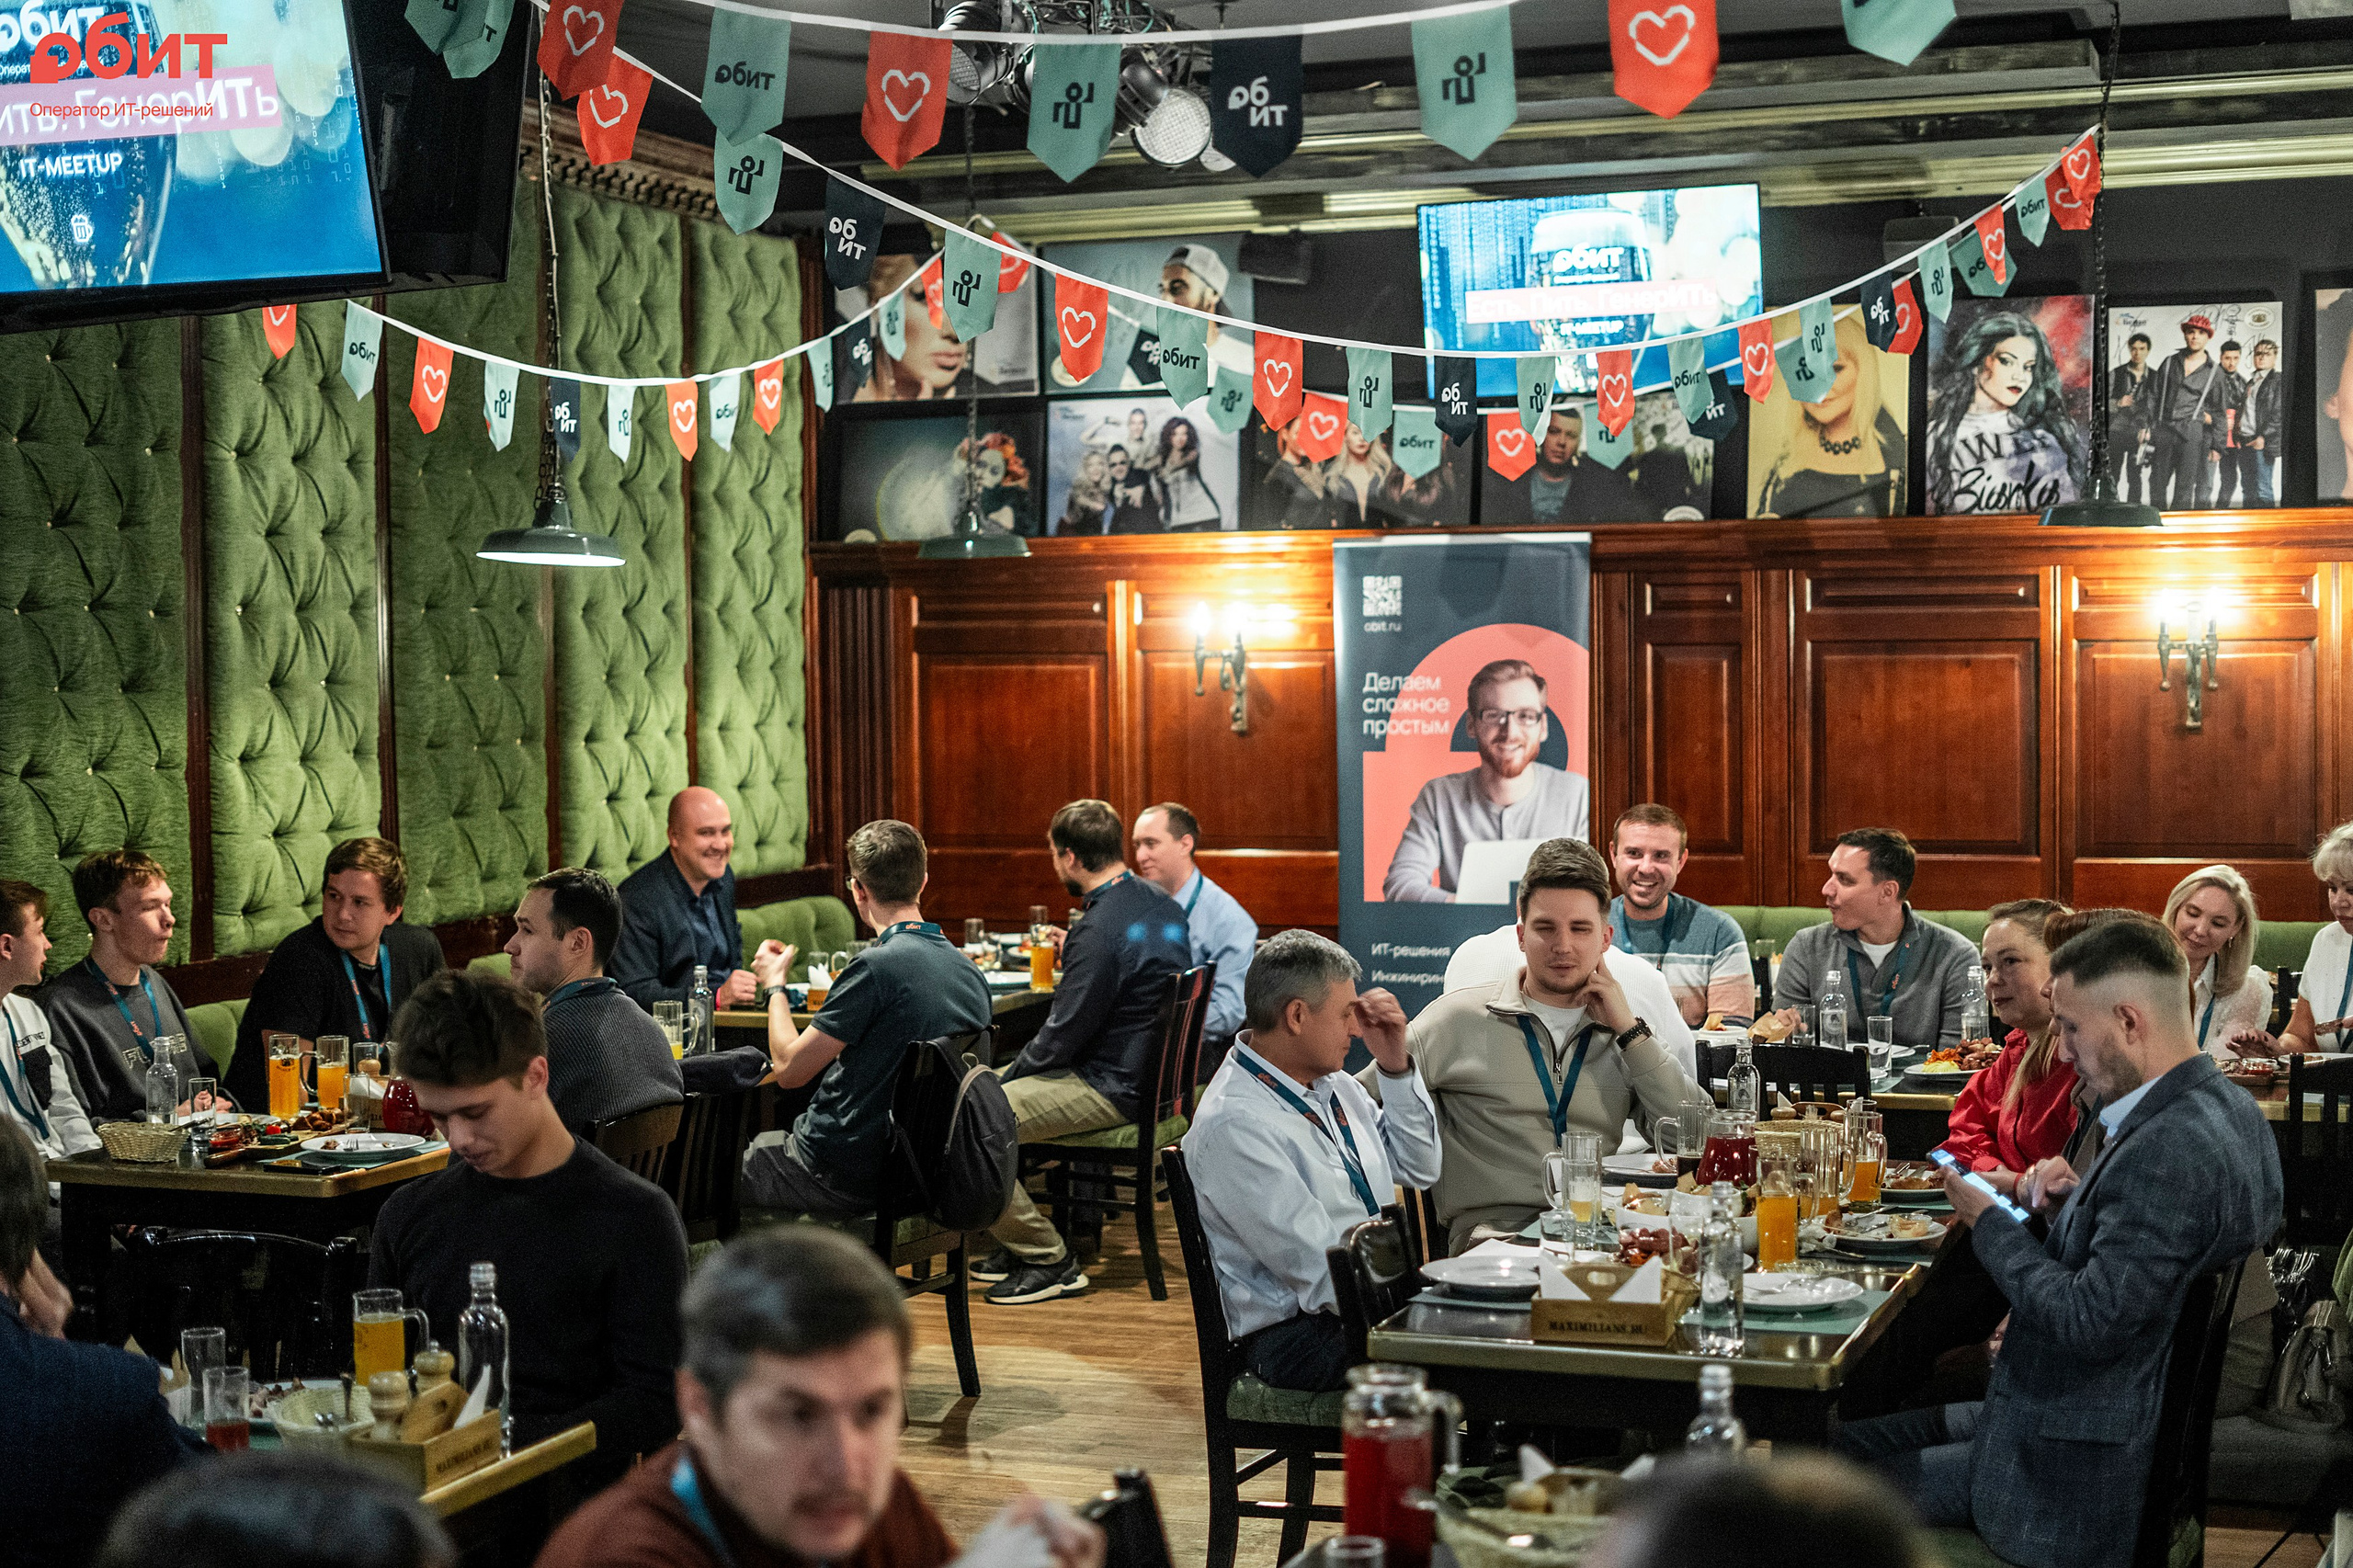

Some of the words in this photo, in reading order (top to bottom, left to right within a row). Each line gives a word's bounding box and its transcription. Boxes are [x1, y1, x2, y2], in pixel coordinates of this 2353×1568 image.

[19, 153, 122, 178] IT-MEETUP
[1362, 672, 1441, 694] Делаем
[1362, 697, 1450, 714] сложное
[1362, 718, 1450, 739] простым
[1371, 942, 1451, 959] ИТ-решения
[1371, 970, 1444, 986] Инжинирин
